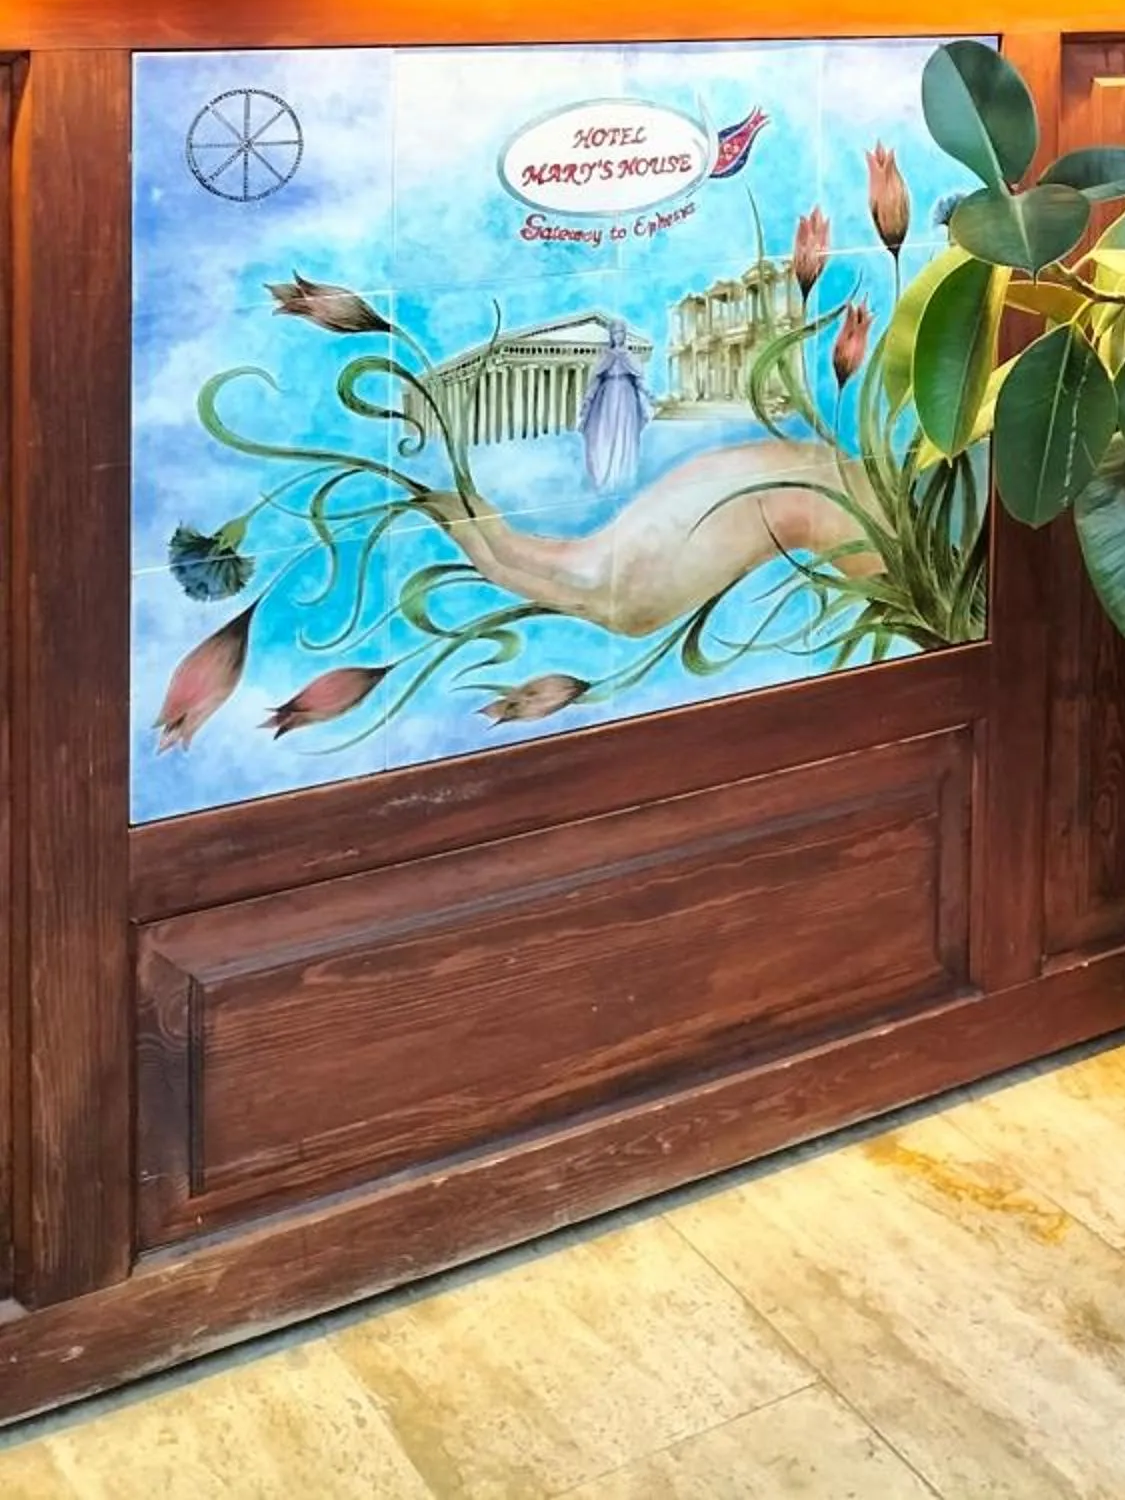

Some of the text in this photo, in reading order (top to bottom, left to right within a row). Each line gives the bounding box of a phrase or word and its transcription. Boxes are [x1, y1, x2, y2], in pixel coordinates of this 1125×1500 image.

[573, 127, 647, 150] HOTEL
[520, 154, 693, 187] MARY'S HOUSE
[610, 225, 627, 241] to
